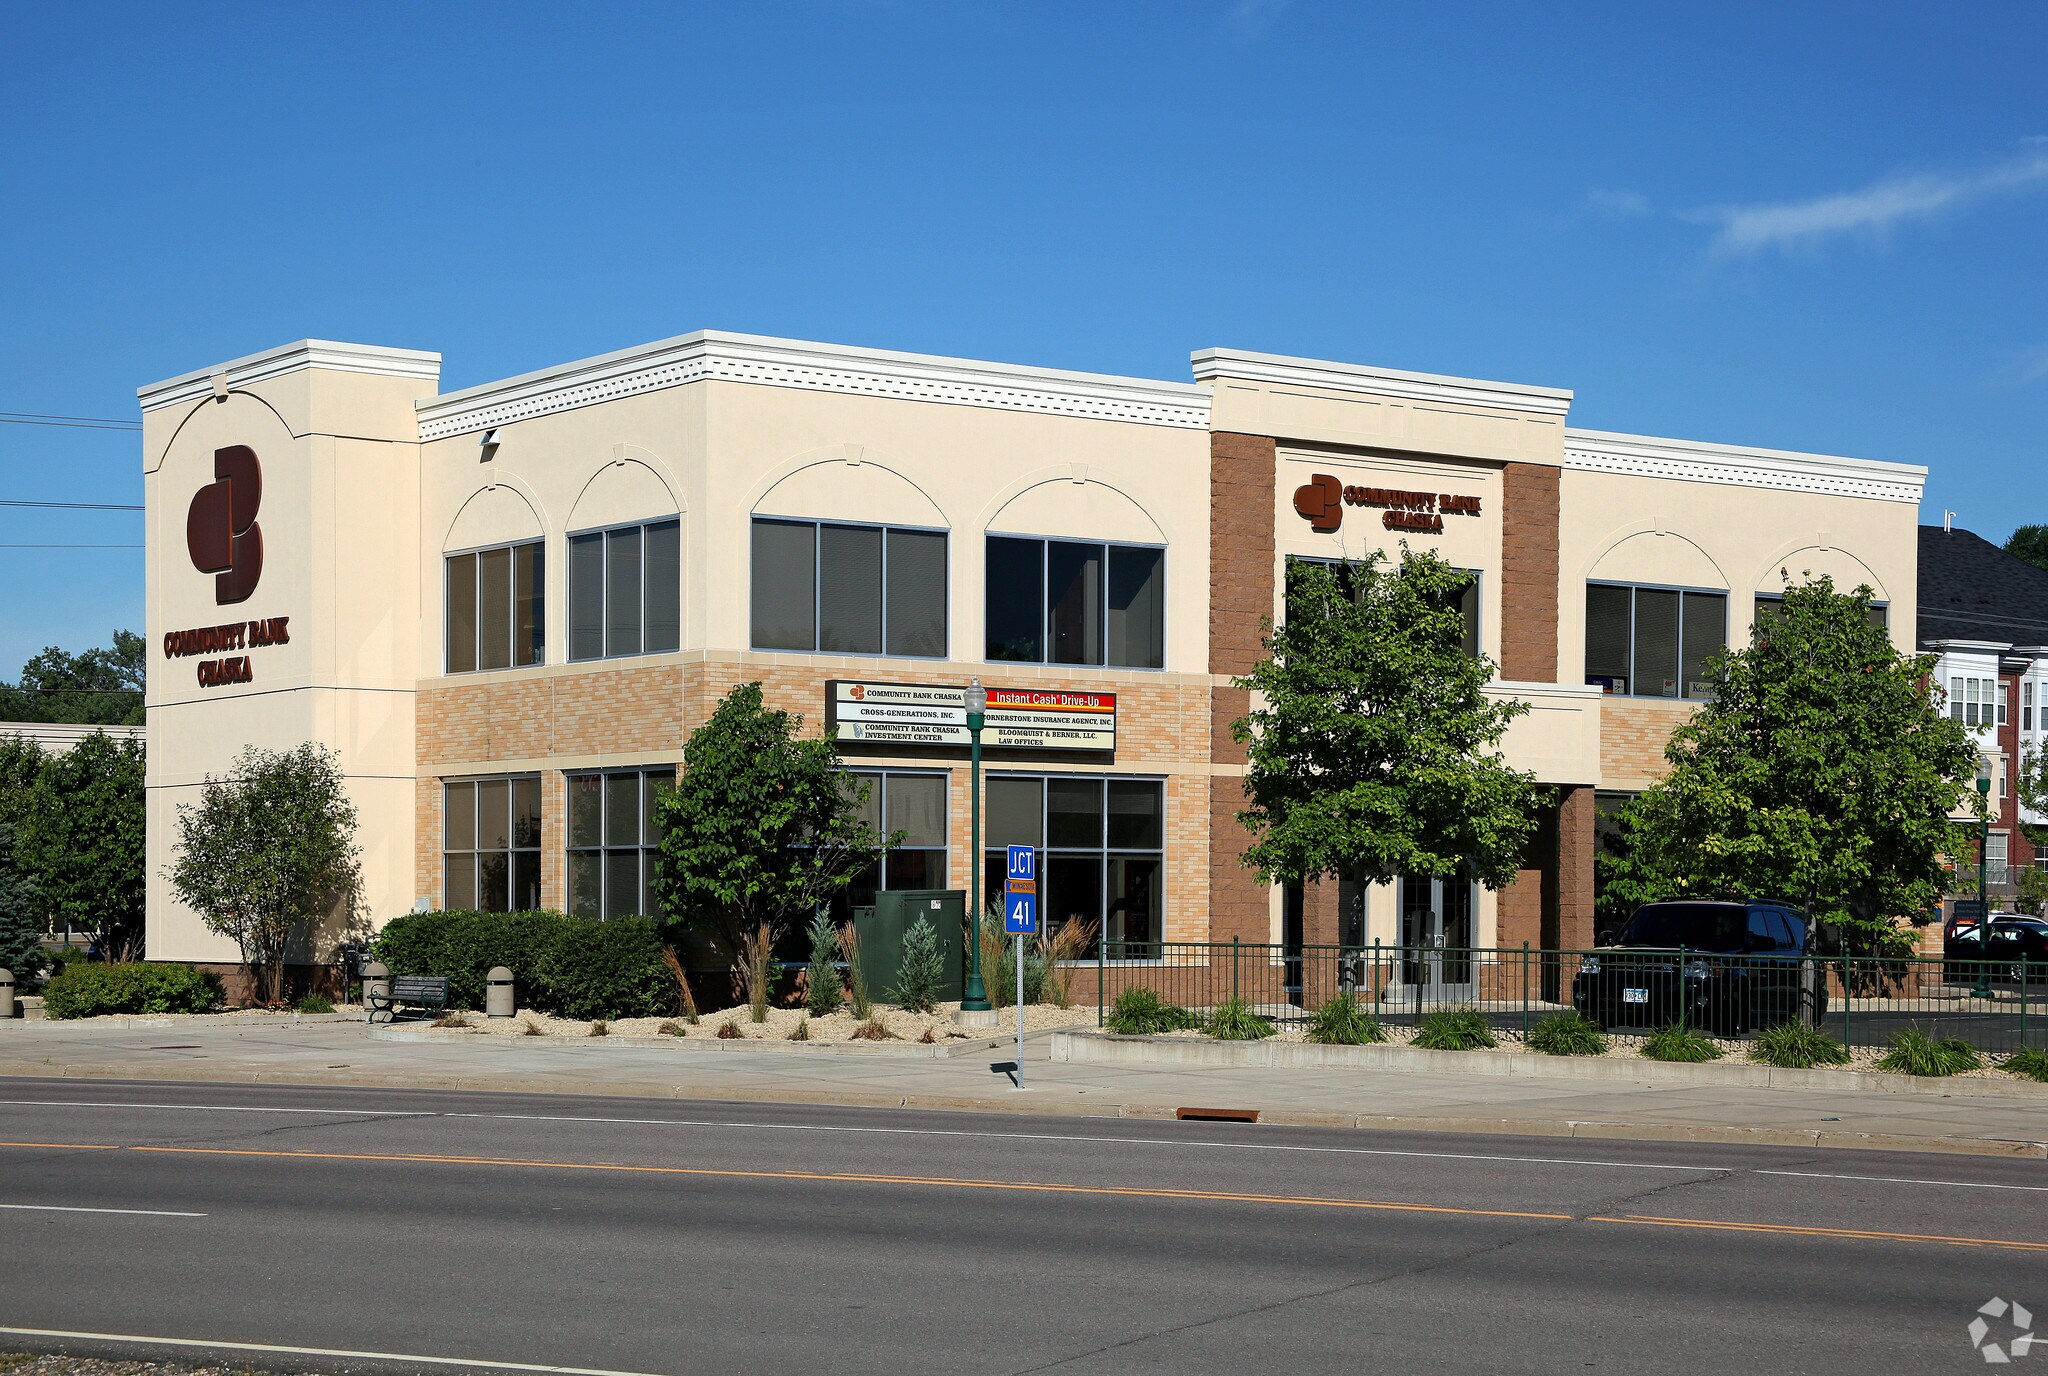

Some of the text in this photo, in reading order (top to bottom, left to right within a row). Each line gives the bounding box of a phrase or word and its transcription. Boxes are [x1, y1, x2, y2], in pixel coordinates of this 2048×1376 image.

[1343, 485, 1482, 514] COMMUNITY BANK
[1382, 511, 1444, 532] CHASKA
[163, 616, 290, 659] COMMUNITY BANK
[197, 655, 253, 688] CHASKA
[1692, 682, 1719, 694] Kempe
[867, 690, 962, 701] COMMUNITY BANK CHASKA
[997, 692, 1030, 704] Instant
[1061, 694, 1099, 707] Drive-Up
[860, 708, 939, 719] CROSS-GENERATIONS,
[1033, 716, 1070, 724] INSURANCE
[1071, 718, 1099, 726] AGENCY,
[865, 724, 909, 732] COMMUNITY
[932, 726, 960, 734] CHASKA
[998, 729, 1044, 737] BLOOMQUIST
[1052, 732, 1082, 740] BERNER,
[865, 732, 943, 741] INVESTMENT CENTER
[1014, 738, 1043, 746] OFFICES
[1010, 851, 1032, 874] JCT
[1012, 900, 1029, 925] 41
